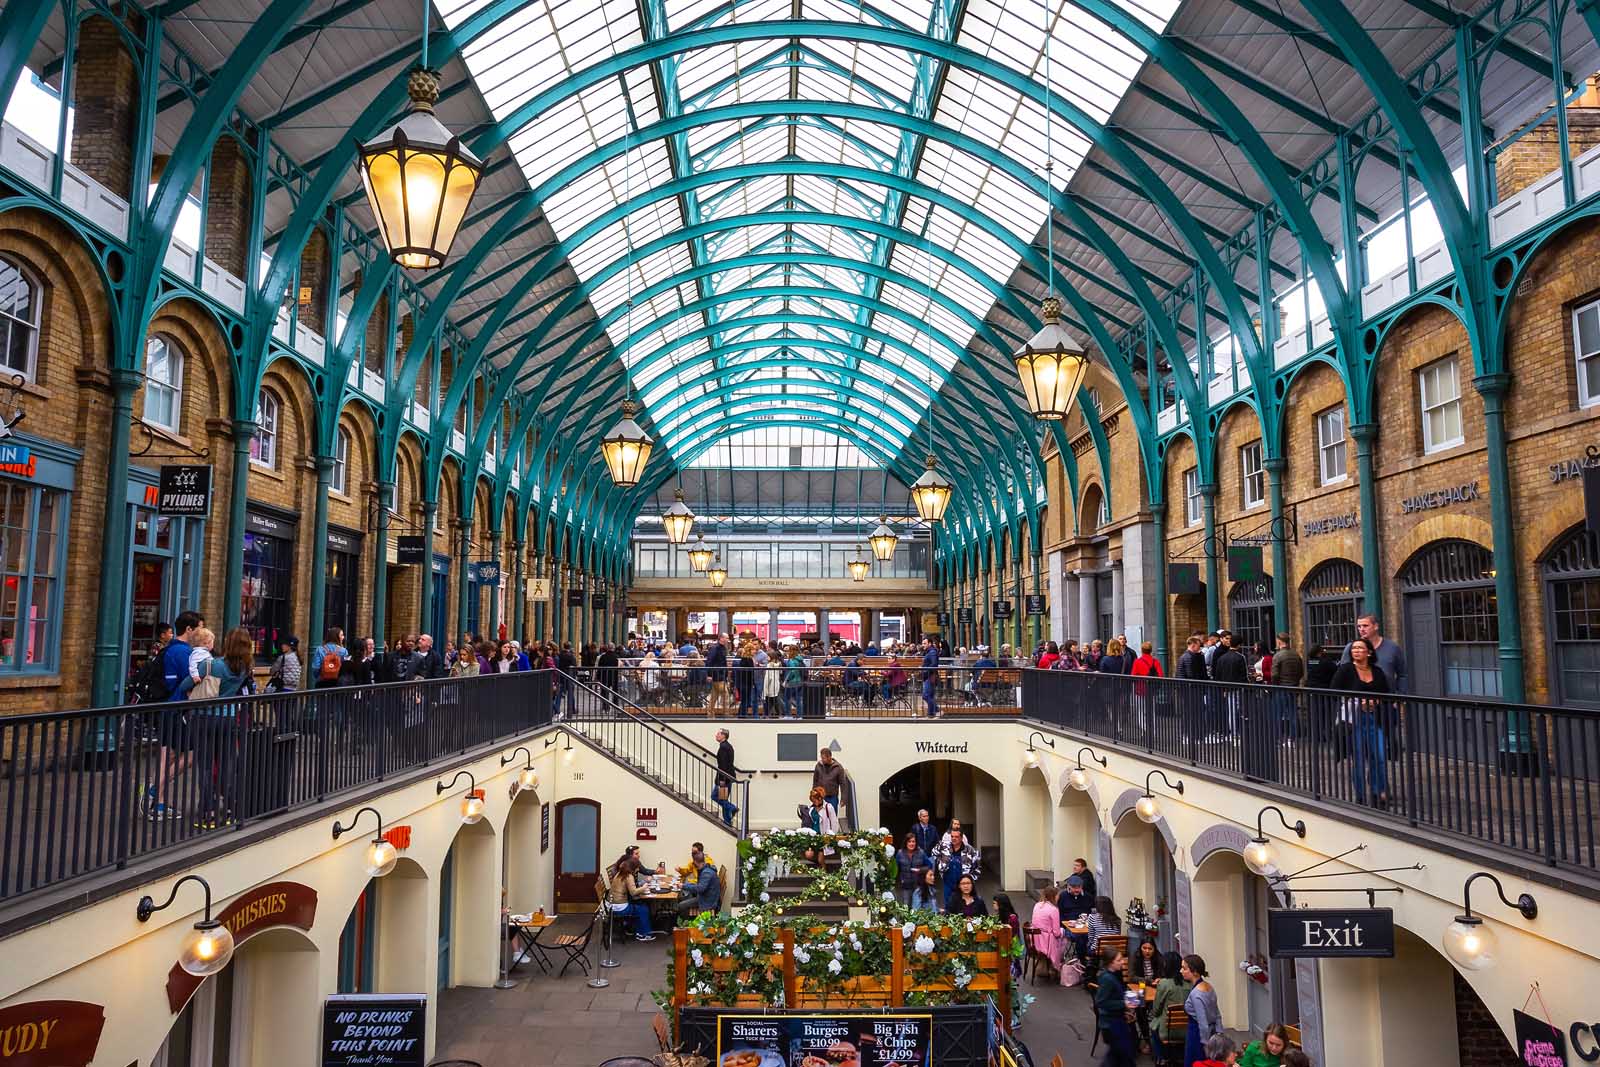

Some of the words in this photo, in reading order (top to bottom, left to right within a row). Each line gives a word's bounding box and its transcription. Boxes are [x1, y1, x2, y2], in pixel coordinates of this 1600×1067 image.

[162, 494, 205, 506] PYLONES
[1400, 491, 1438, 515] SHAKE
[1437, 480, 1480, 506] SHACK
[1303, 518, 1328, 537] SHAKE
[1328, 511, 1358, 533] SHACK
[915, 741, 968, 754] Whittard
[1301, 919, 1364, 947] Exit
[335, 1011, 357, 1024] NO
[358, 1010, 413, 1023] DRINKS
[344, 1025, 403, 1037] BEYOND
[733, 1025, 778, 1036] Sharers
[804, 1025, 849, 1038] Burgers
[874, 1024, 892, 1037] Big
[895, 1024, 919, 1035] Fish
[0, 1019, 58, 1057] UDY
[810, 1038, 840, 1048] £10.99
[876, 1037, 883, 1046] &
[884, 1036, 917, 1050] Chips
[330, 1039, 367, 1052] THIS
[367, 1038, 418, 1052] POINT
[345, 1055, 374, 1066] Thank
[374, 1054, 394, 1067] You
[878, 1049, 914, 1060] £14.99
